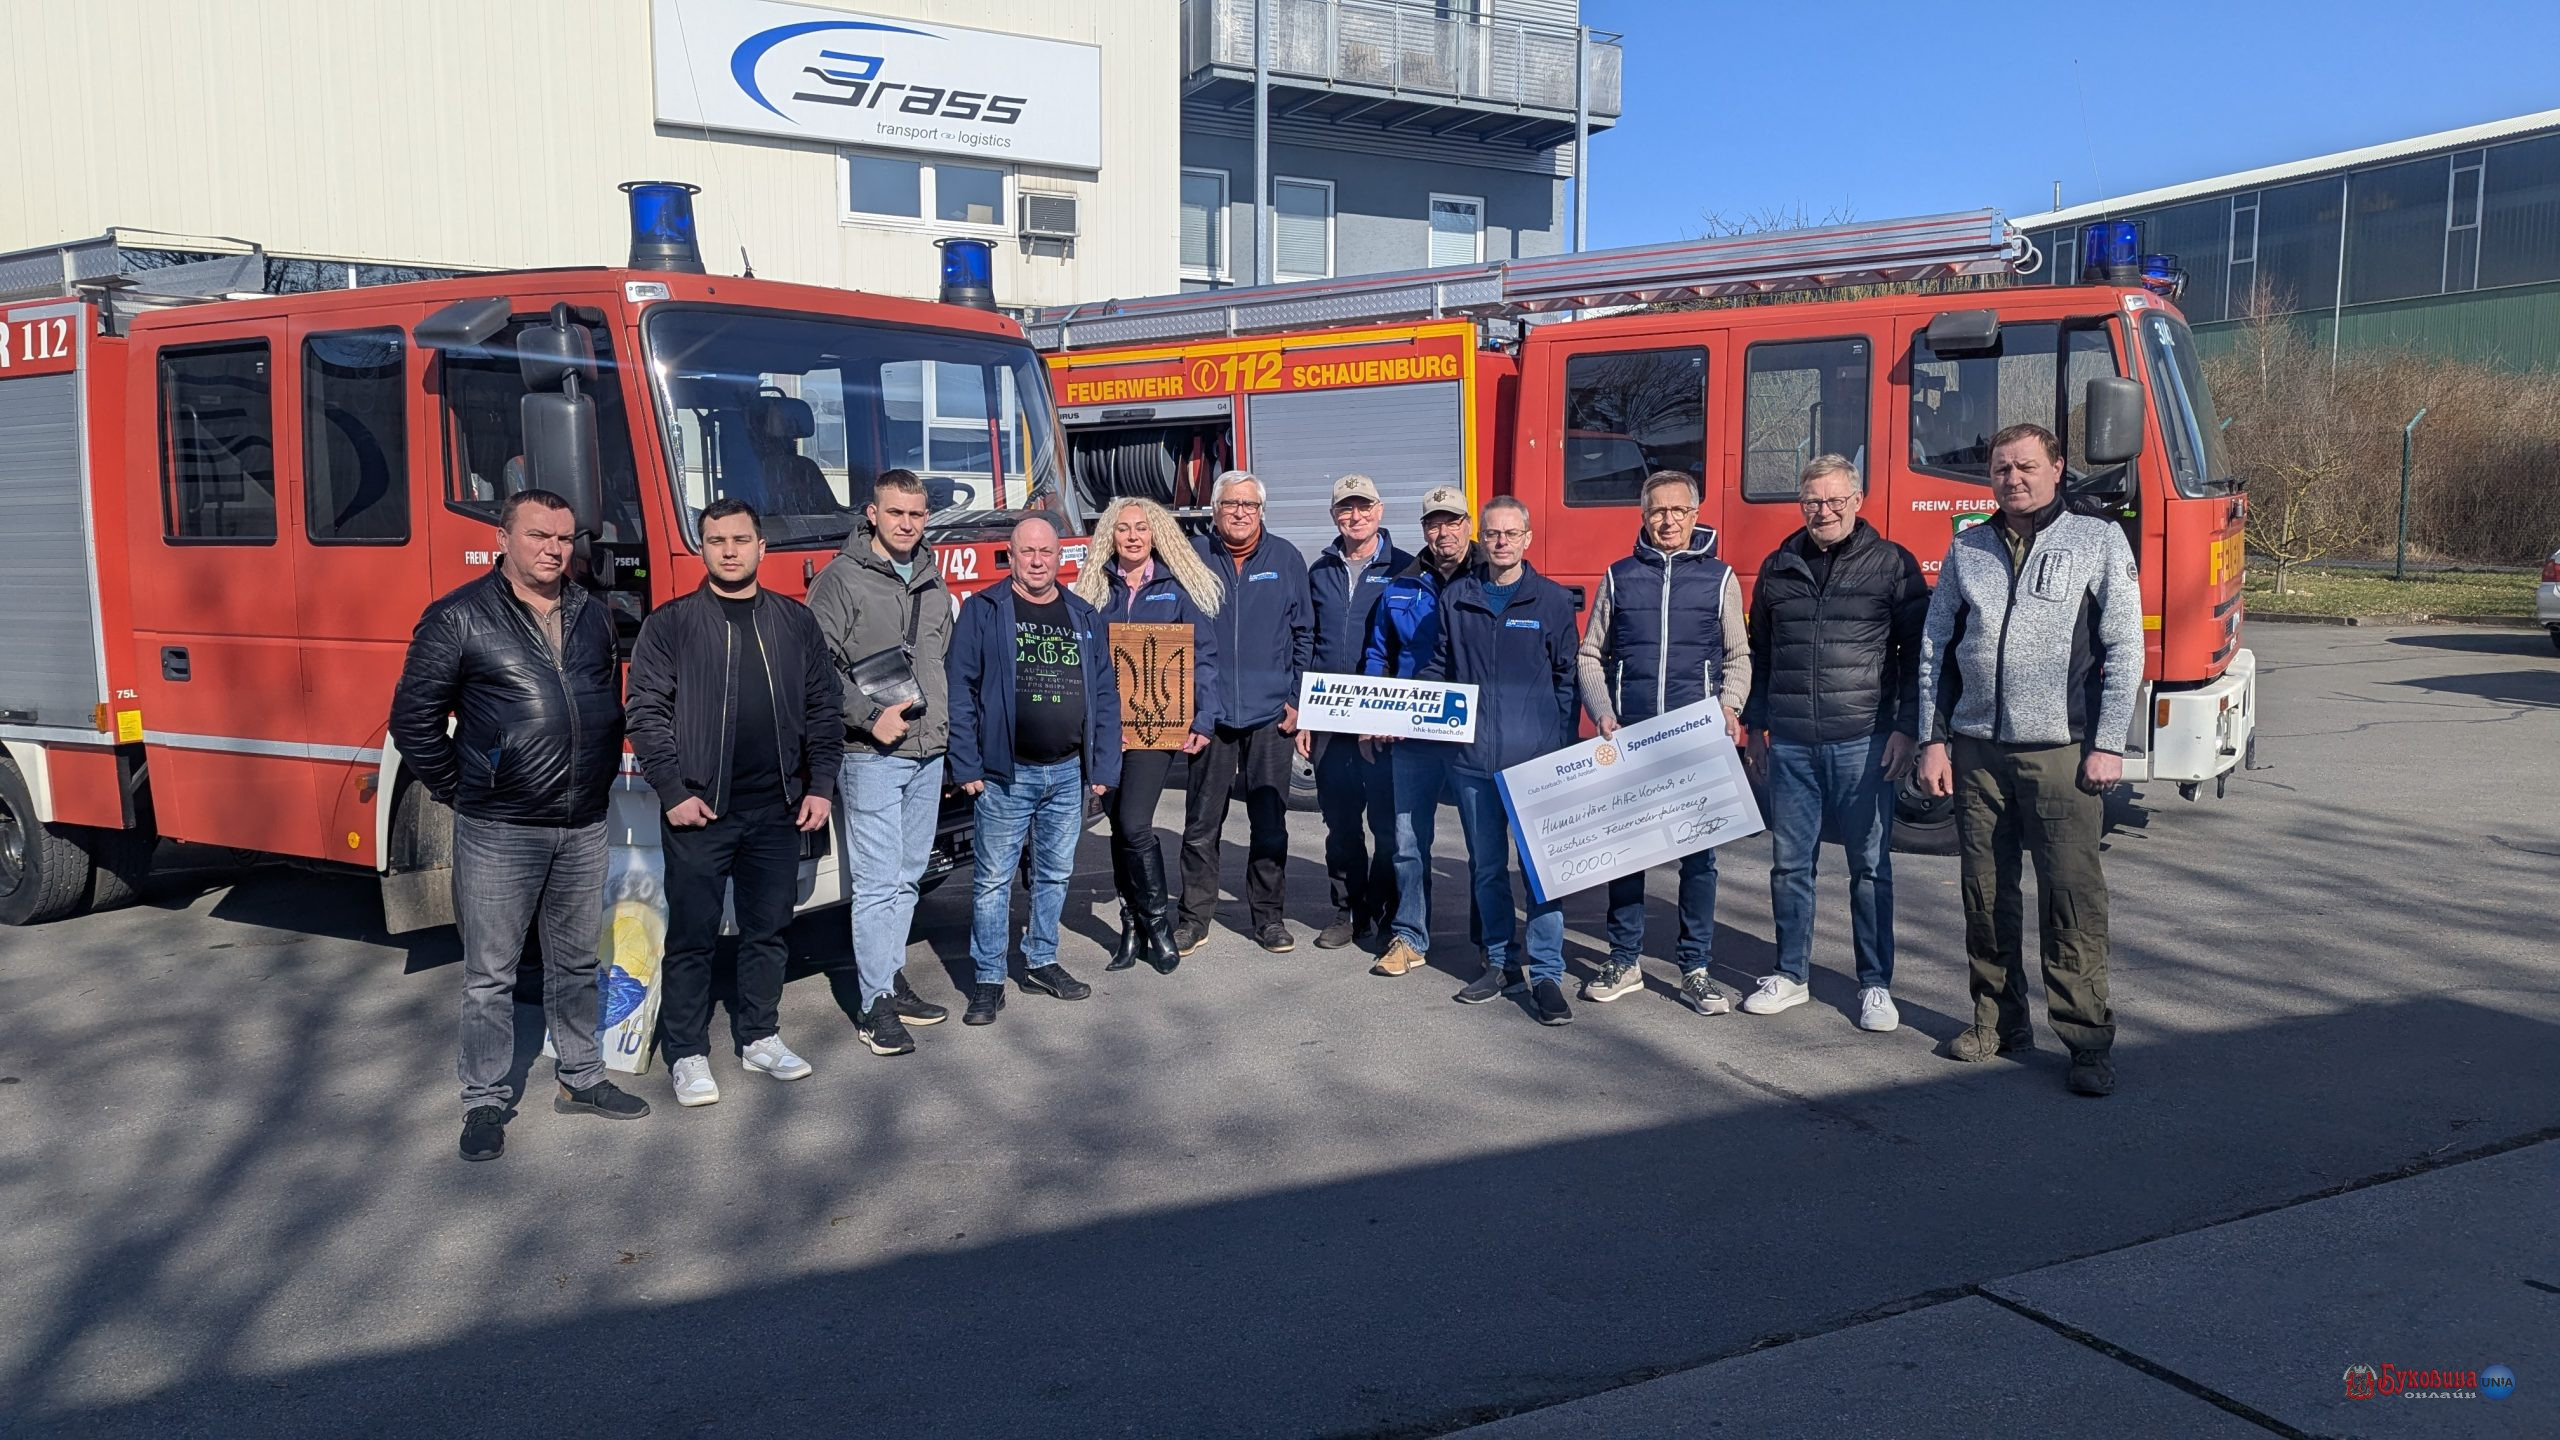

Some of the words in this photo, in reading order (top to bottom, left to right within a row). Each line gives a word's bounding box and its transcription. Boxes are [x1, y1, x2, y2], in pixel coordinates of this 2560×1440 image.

[876, 121, 938, 142] transport
[957, 130, 1012, 149] logistics
[21, 318, 69, 361] 112
[1067, 375, 1184, 403] FEUERWEHR
[1219, 351, 1284, 392] 112
[1292, 354, 1458, 388] SCHAUENBURG
[1059, 412, 1080, 420] IRUS
[1911, 500, 1954, 512] FREIW.
[465, 551, 491, 565] FREIW.
[614, 557, 640, 567] 75E14
[1024, 632, 1041, 641] BLUE
[116, 688, 139, 699] 75L
[1032, 694, 1042, 702] 25
[1052, 695, 1061, 703] 01
[1328, 684, 1443, 702] HUMANITÄRE
[1308, 694, 1355, 708] HILFE
[1359, 698, 1442, 714] KORBACH
[1328, 708, 1351, 717] E.V.
[1413, 726, 1465, 736] hhk-korbach.de
[1555, 756, 1594, 777] Rotary
[1626, 714, 1713, 752] Spendenscheck
[1527, 786, 1541, 796] Club
[1540, 778, 1563, 791] Korbach
[1541, 803, 1608, 835] Humanitäre
